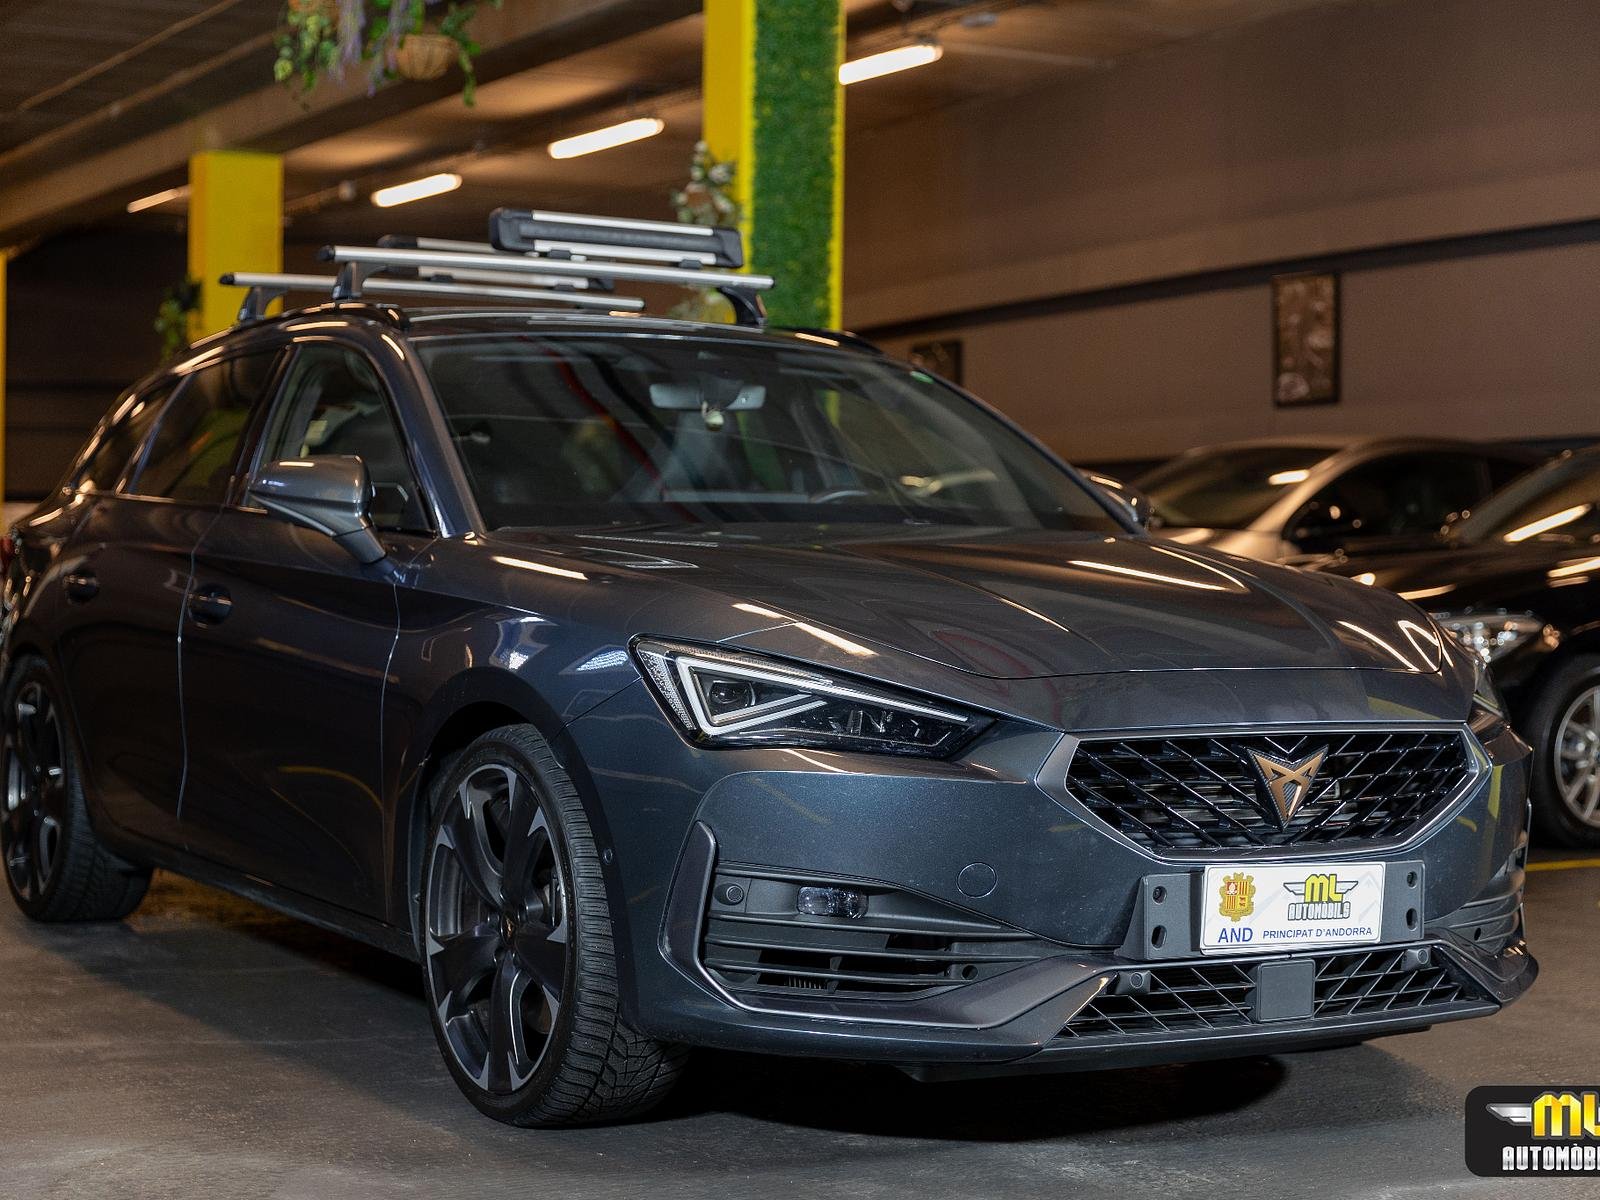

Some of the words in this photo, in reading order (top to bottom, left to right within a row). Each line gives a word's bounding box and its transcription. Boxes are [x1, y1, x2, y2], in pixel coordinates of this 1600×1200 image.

[1304, 873, 1343, 903] ML
[1218, 927, 1254, 943] AND
[1262, 928, 1314, 939] PRINCIPAT
[1315, 926, 1373, 938] D'ANDORRA
